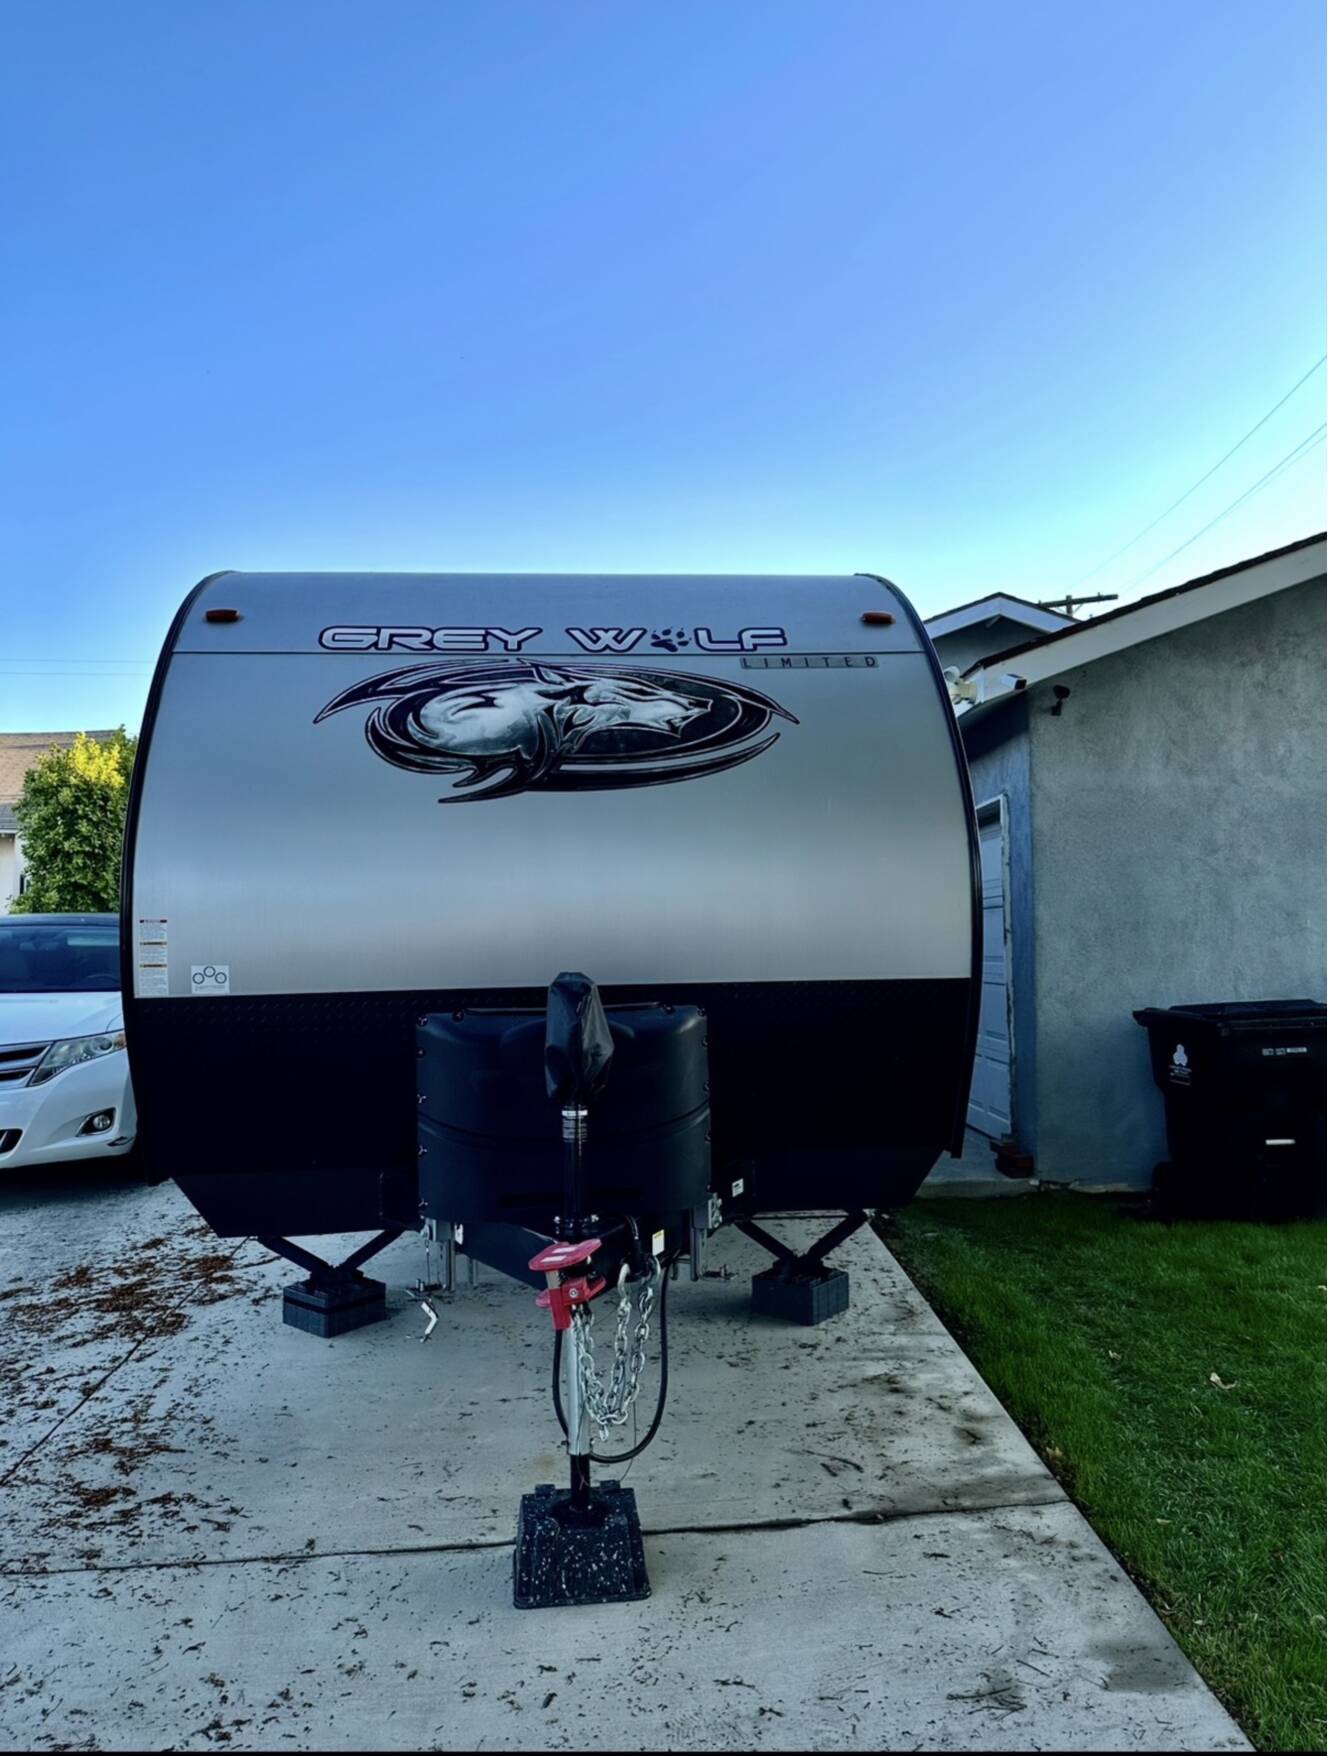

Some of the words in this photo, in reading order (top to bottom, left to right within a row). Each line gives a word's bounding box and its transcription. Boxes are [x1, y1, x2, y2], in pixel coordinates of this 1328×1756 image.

[318, 625, 543, 652] GREY
[565, 626, 788, 653] WLF
[742, 656, 876, 669] LIMITED
